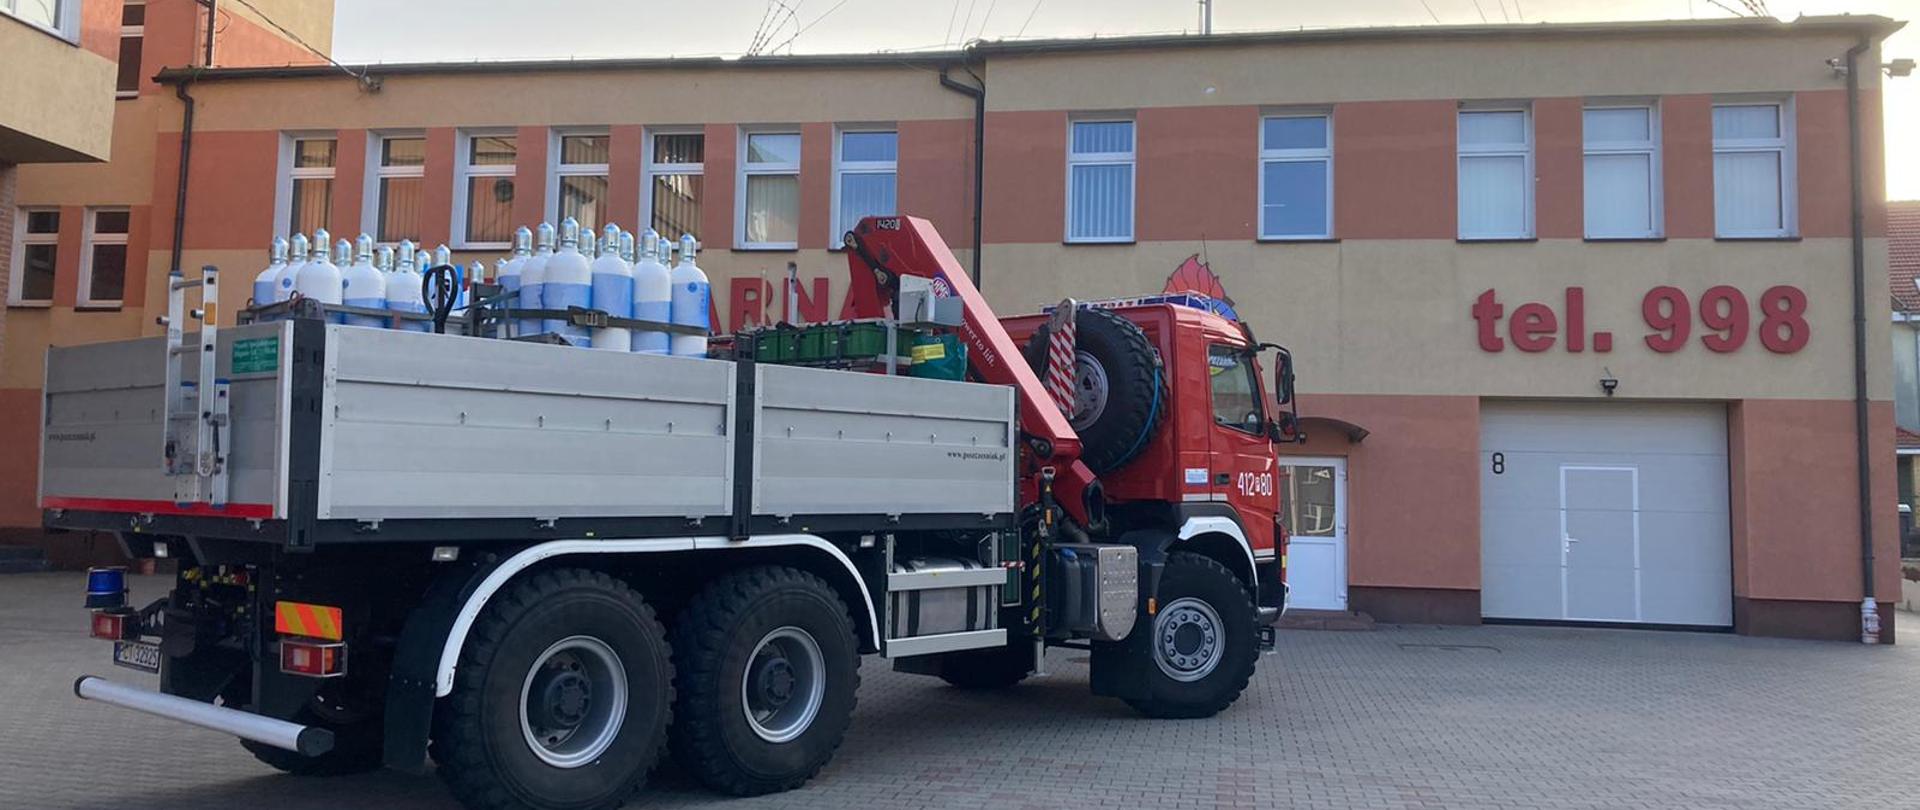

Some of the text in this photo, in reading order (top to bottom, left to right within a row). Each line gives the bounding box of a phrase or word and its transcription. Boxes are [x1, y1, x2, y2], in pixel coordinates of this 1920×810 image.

[1472, 285, 1810, 354] tel. 998
[1492, 452, 1504, 474] 8
